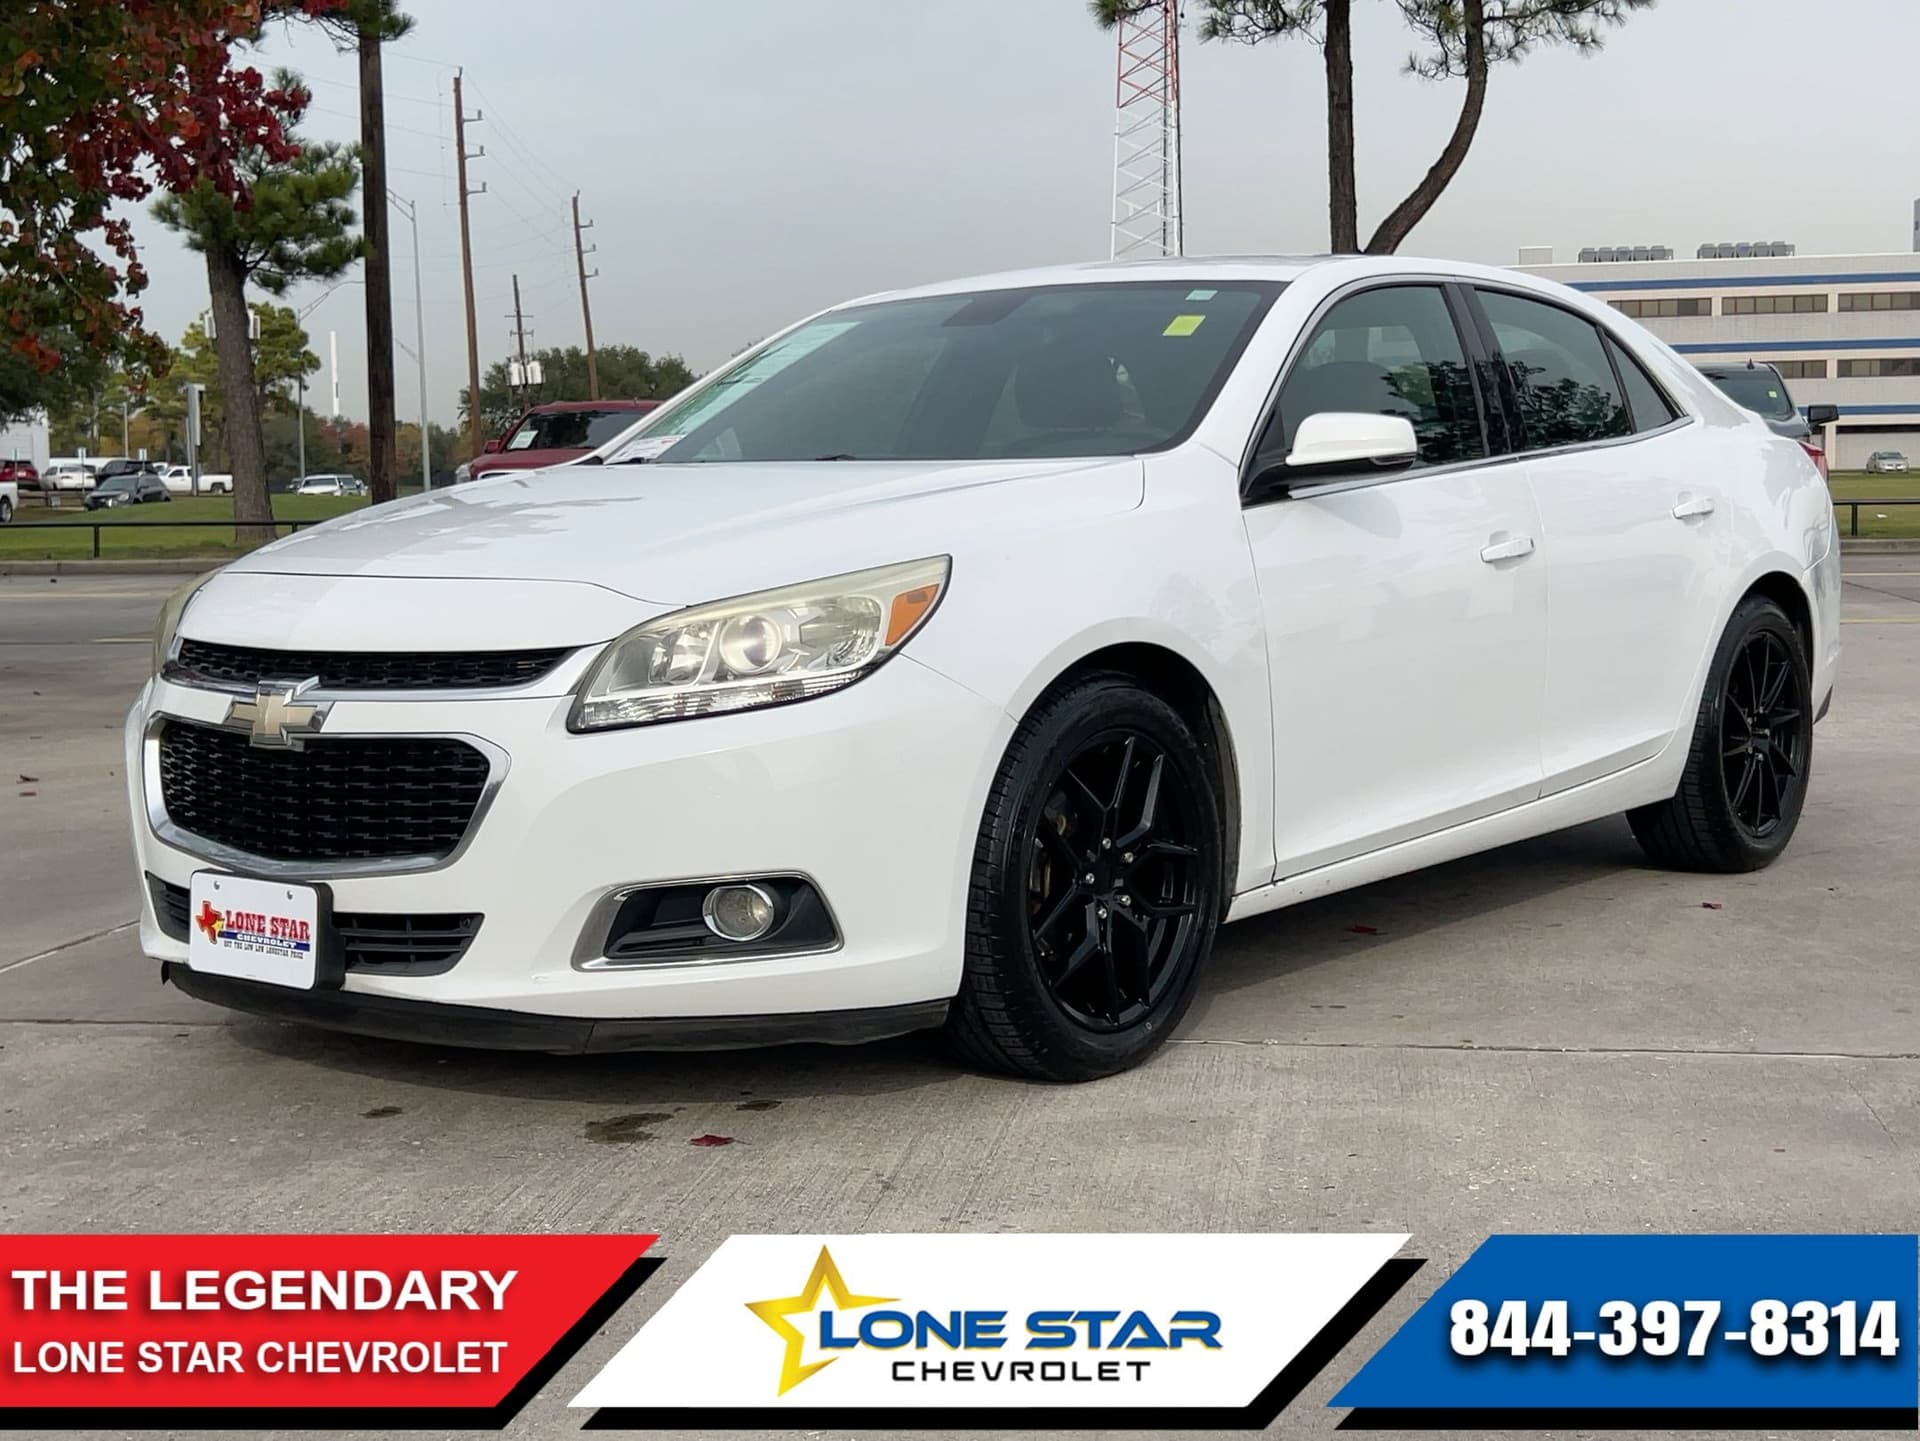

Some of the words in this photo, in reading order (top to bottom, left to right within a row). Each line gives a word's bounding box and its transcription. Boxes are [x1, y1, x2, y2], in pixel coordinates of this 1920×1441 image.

[225, 910, 266, 934] LONE
[270, 916, 310, 940] STAR
[237, 933, 297, 948] CHEVROLET
